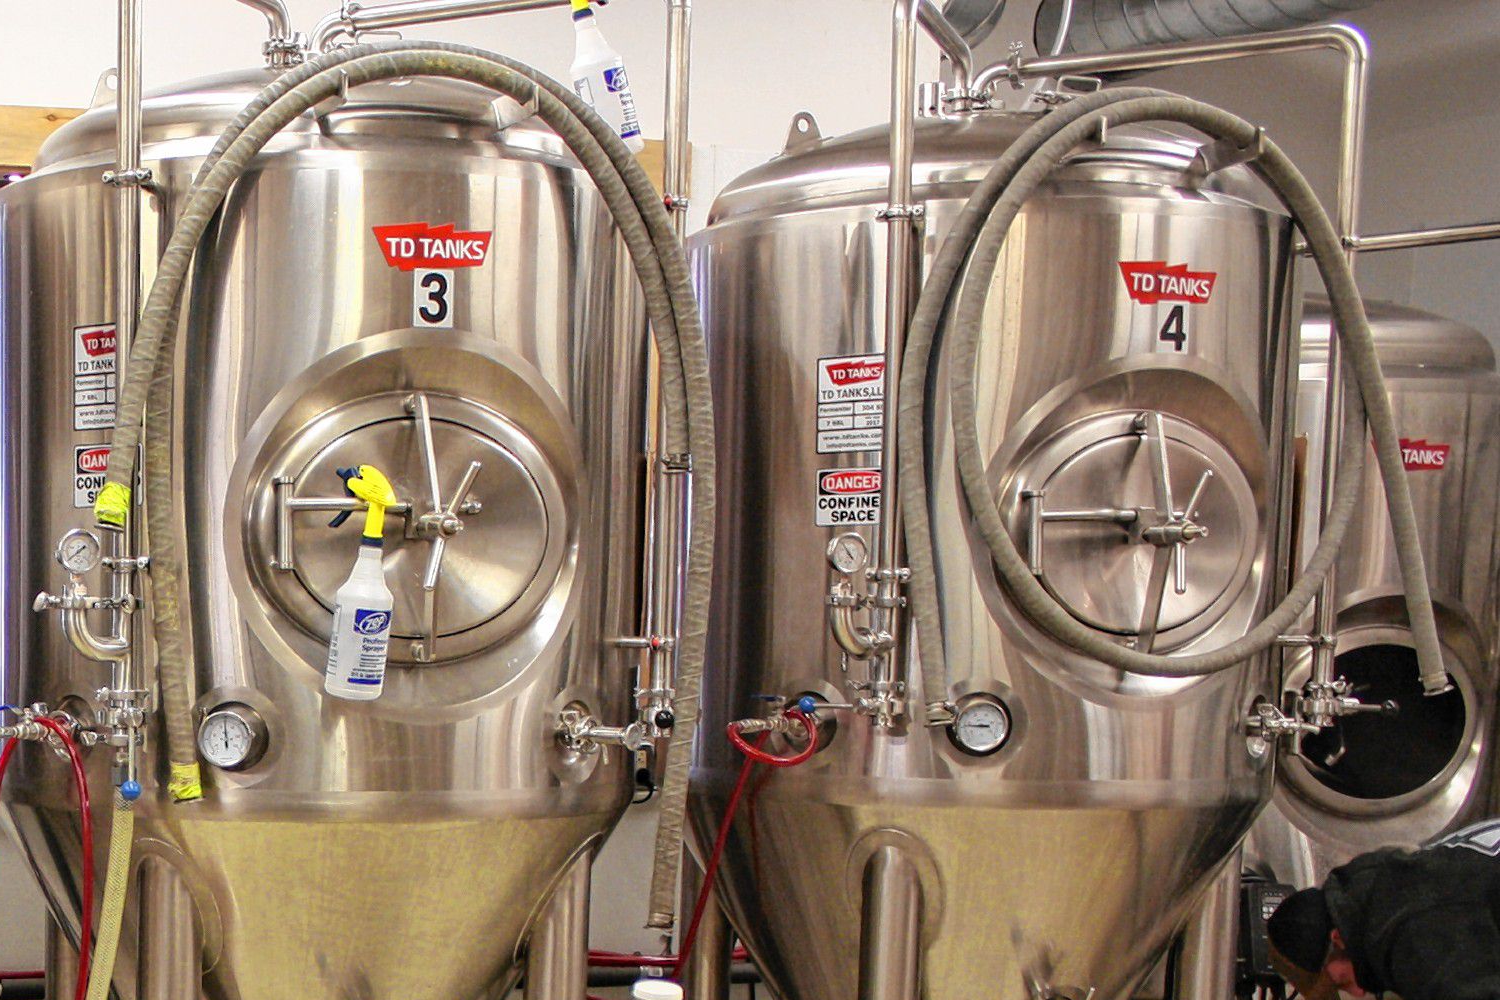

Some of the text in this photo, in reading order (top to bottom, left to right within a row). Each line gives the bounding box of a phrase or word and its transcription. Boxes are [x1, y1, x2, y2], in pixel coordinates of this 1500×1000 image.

[385, 237, 484, 260] TD TANKS
[1130, 272, 1211, 299] TD TANKS
[419, 272, 448, 324] 3
[1160, 305, 1187, 351] 4
[101, 337, 116, 348] TAN
[91, 359, 114, 371] TANK
[832, 366, 880, 380] TD TANKS
[821, 386, 884, 400] TD TANKS,LL
[82, 454, 109, 468] DAN
[1402, 448, 1444, 466] TANKS
[825, 475, 881, 489] DANGER
[818, 496, 880, 510] CONFINE
[831, 509, 875, 523] SPACE
